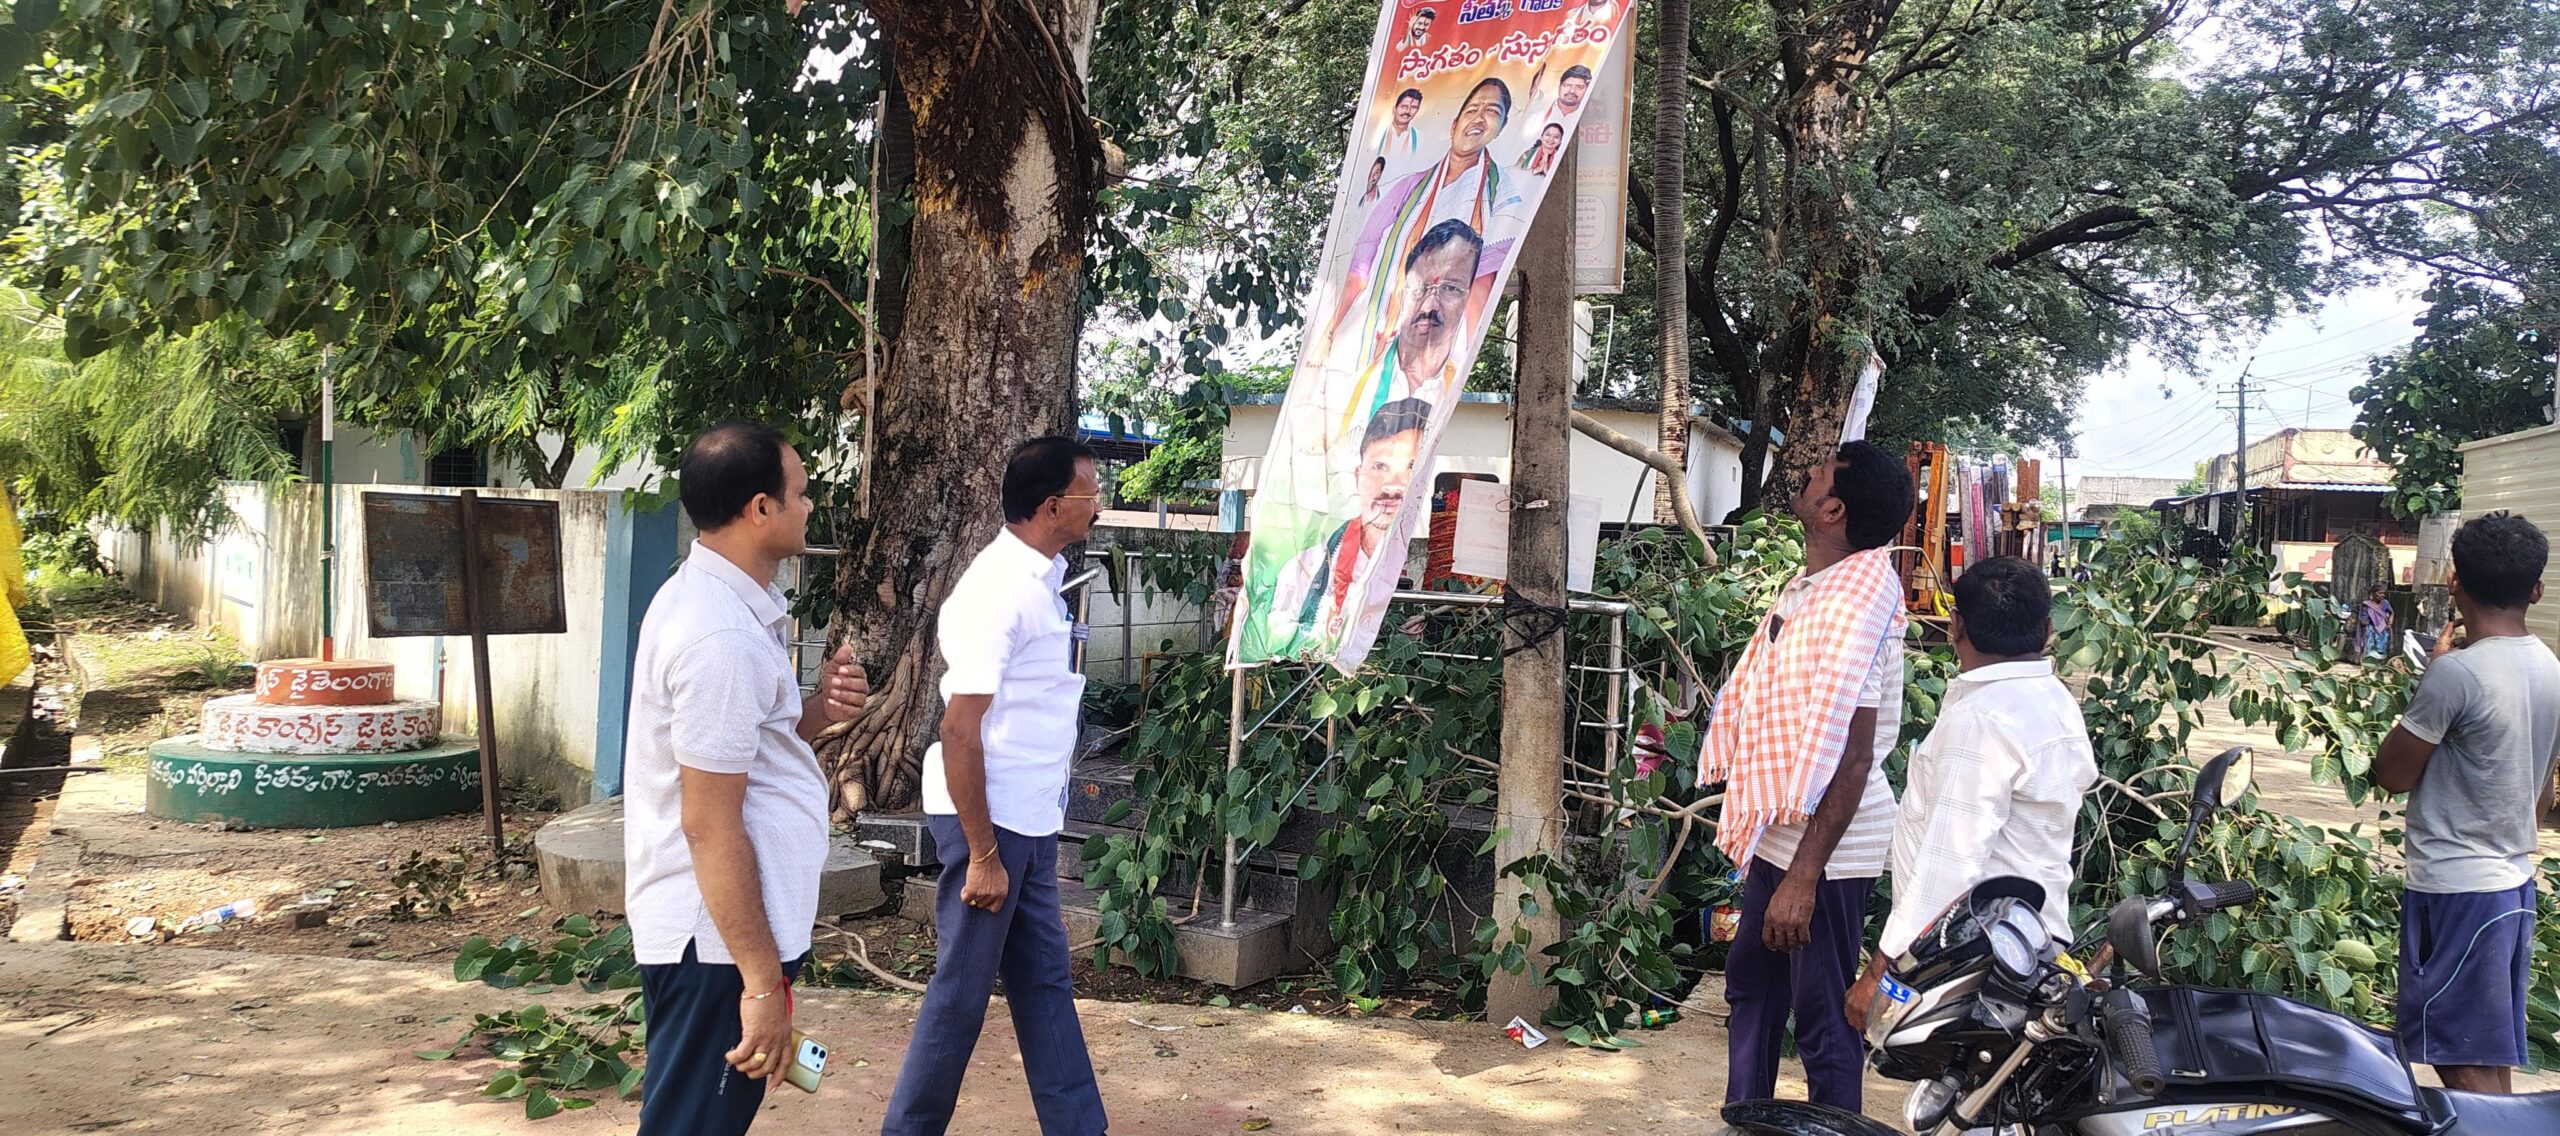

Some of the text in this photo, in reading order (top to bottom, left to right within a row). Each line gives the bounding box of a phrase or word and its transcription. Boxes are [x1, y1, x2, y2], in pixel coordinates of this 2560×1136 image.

[1398, 43, 1480, 79] స్వాగతం
[254, 763, 320, 795] సీతక్క
[2144, 1103, 2297, 1129] PLATIN
